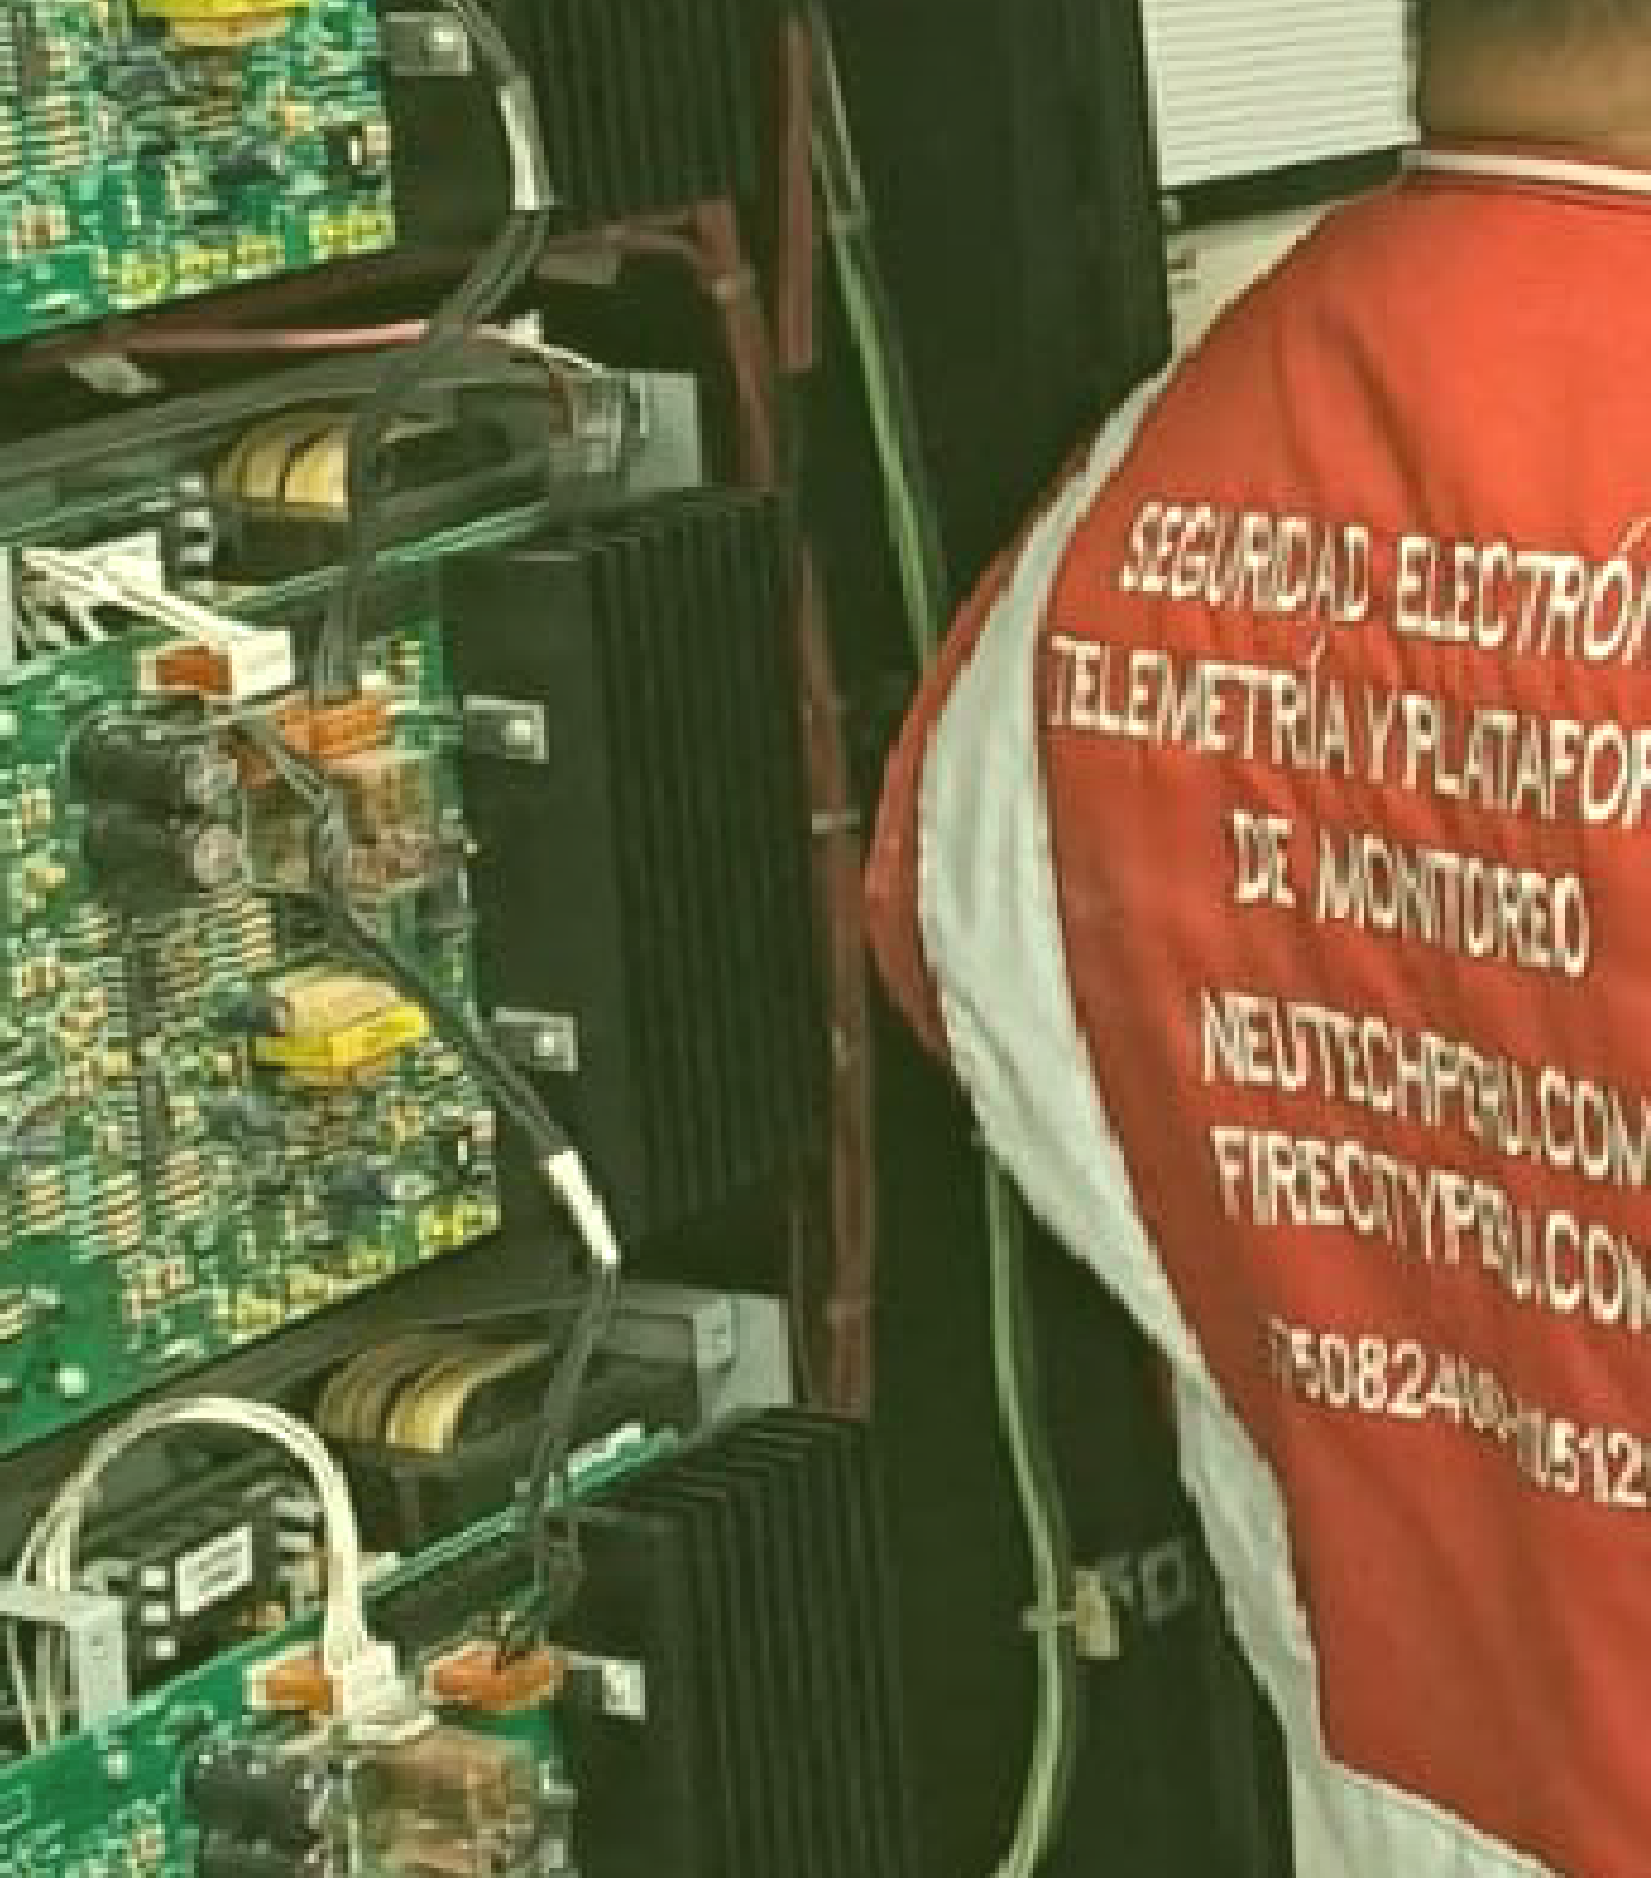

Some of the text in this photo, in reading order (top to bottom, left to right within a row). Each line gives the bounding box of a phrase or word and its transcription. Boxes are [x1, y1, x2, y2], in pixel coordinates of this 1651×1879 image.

[1121, 500, 1370, 622] SEGURIDAD
[1049, 630, 1355, 778] TELEMETRÍA
[1361, 680, 1399, 786] Y
[1233, 808, 1592, 978] DE MONITOREO
